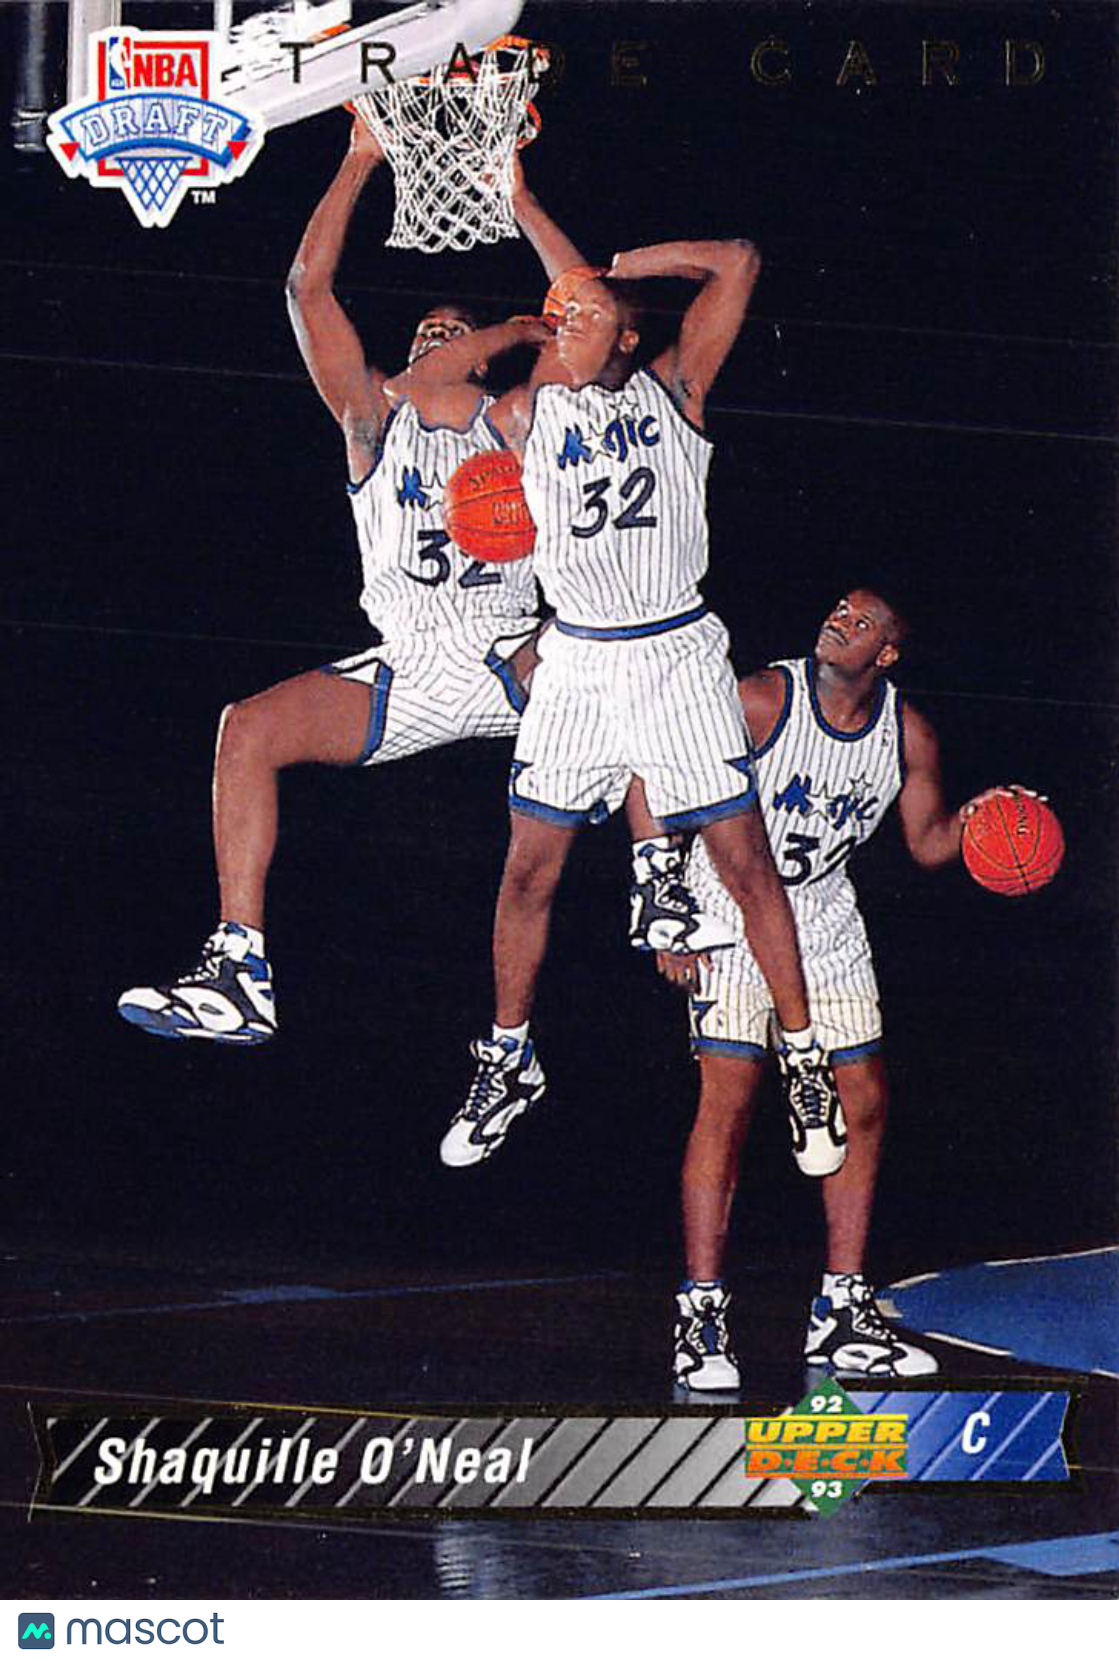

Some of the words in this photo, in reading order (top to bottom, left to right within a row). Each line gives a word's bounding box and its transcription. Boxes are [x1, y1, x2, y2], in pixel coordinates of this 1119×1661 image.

[133, 53, 198, 88] NBA
[279, 41, 647, 86] TRADE
[750, 39, 1047, 86] CARD
[81, 102, 228, 146] DRAFT
[191, 190, 216, 204] TM
[572, 466, 658, 539] 32
[811, 1396, 842, 1413] 92
[748, 1420, 908, 1444] UPPER
[962, 1412, 990, 1454] C
[94, 1437, 338, 1493] Shaquille
[811, 1481, 842, 1498] 93
